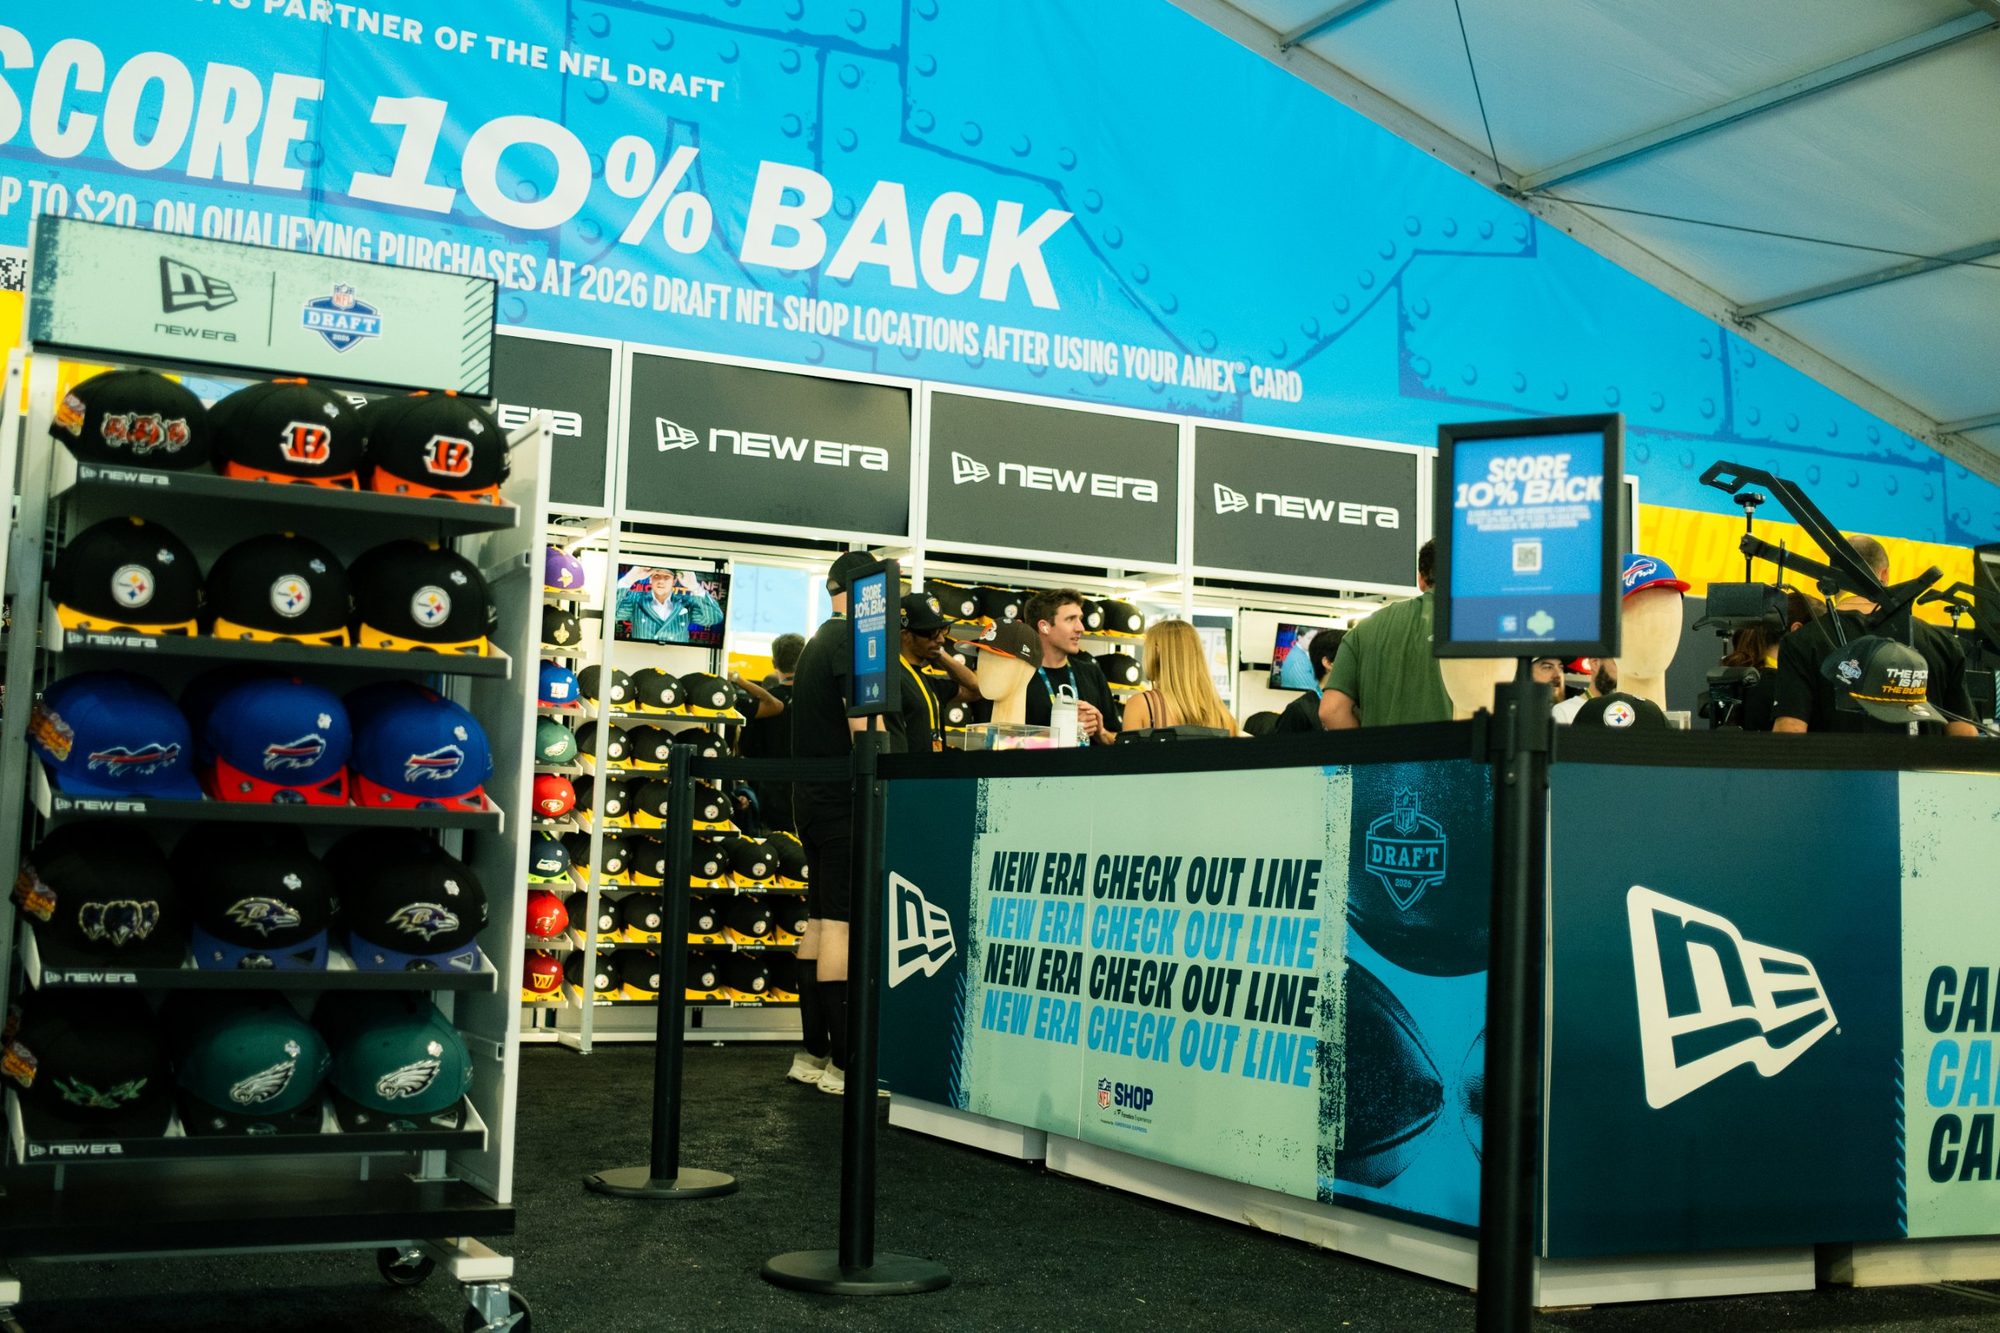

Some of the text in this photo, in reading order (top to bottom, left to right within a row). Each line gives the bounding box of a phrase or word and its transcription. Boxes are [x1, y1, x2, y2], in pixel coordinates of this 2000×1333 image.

[264, 0, 725, 103] PARTNER OF THE NFL DRAFT
[348, 95, 713, 254] 10%
[739, 159, 1074, 311] BACK
[0, 175, 22, 216] P
[29, 180, 68, 220] TO
[153, 199, 196, 236] ON
[202, 205, 372, 261] QUALIFYING
[378, 231, 537, 291] PURCHASES
[541, 257, 576, 297] AT
[579, 264, 648, 309] 2026
[653, 274, 731, 321] DRAFT
[736, 286, 779, 329] NFL
[782, 295, 849, 338] SHOP
[853, 304, 979, 359] LOCATIONS
[983, 324, 1049, 367] AFTER
[1053, 334, 1119, 375] USING
[1122, 344, 1178, 386] YOUR
[1249, 365, 1302, 403] CARD
[308, 312, 377, 333] DRAFT
[1454, 475, 1604, 509] 10% BACK
[1487, 453, 1571, 483] SCORE
[1882, 685, 1903, 694] THE
[1886, 668, 1913, 678] THE
[1898, 679, 1911, 687] IS
[988, 851, 1323, 911] NEW ERA CHECK OUT LINE
[1372, 843, 1438, 868] DRAFT
[1395, 878, 1412, 888] 2026
[985, 896, 1321, 969] NEW ERA CHECK OUT LINE
[983, 943, 1319, 1028] NEW ERA CHECK OUT LINE
[1924, 965, 2000, 1033] CA
[981, 989, 1318, 1088] NEW ERA CHECK OUT LINE
[1114, 1082, 1153, 1112] SHOP
[1926, 1038, 2000, 1109] CA
[1927, 1113, 2000, 1183] CA
